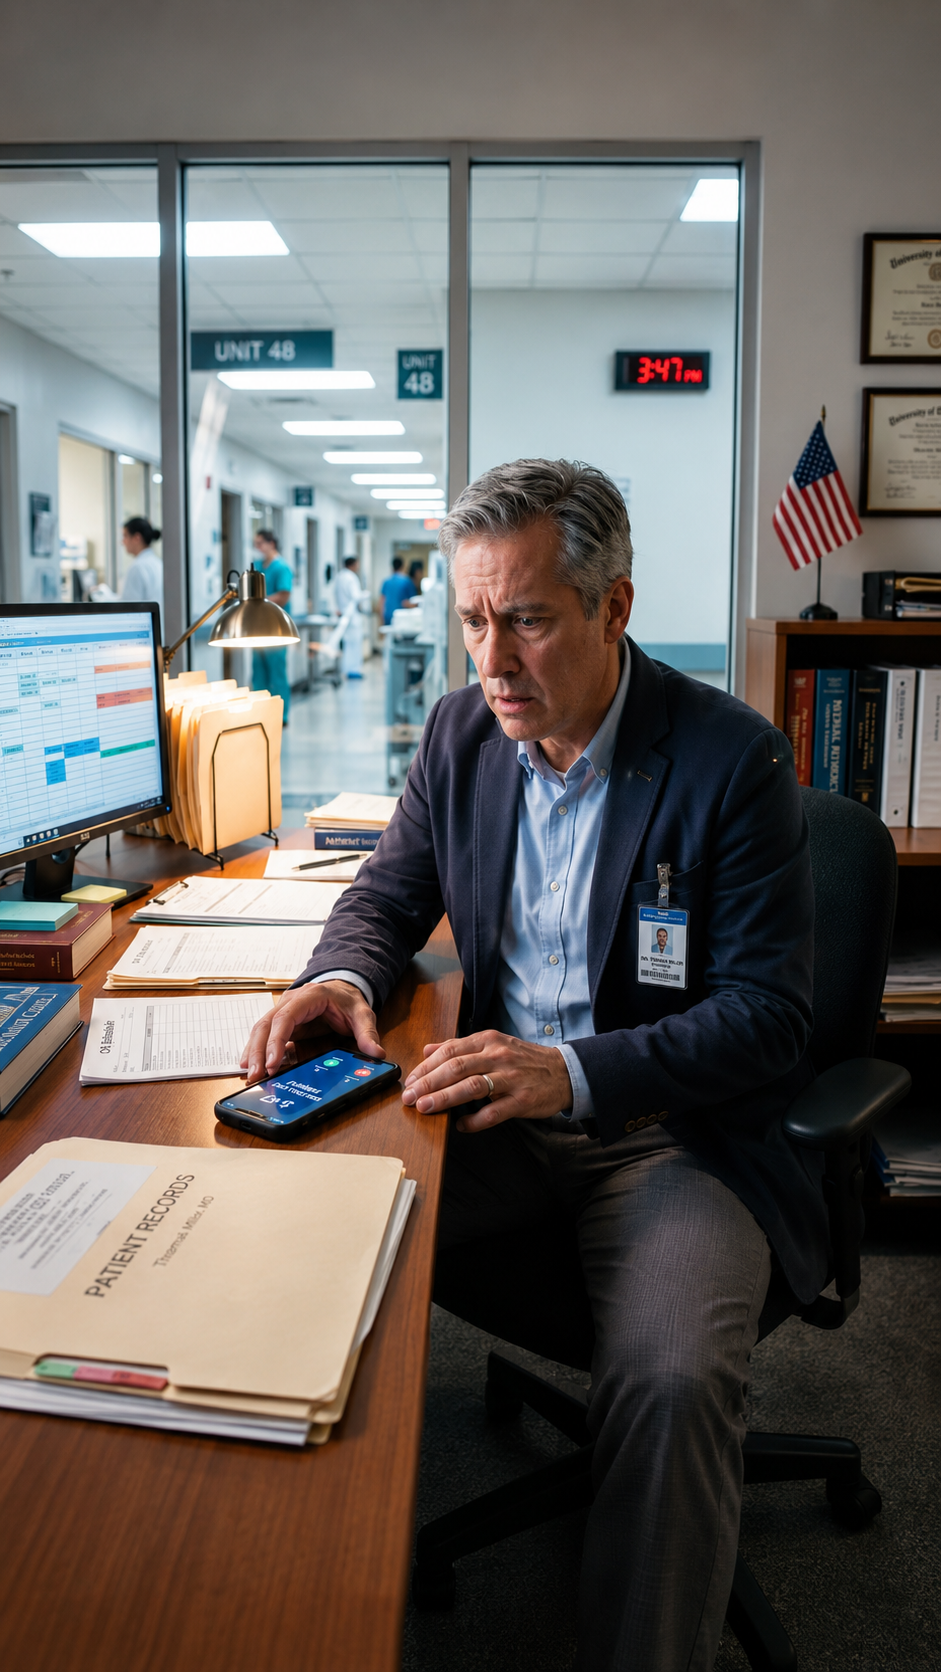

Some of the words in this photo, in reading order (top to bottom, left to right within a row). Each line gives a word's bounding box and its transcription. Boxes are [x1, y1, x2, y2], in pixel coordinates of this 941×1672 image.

[214, 340, 264, 362] UNIT
[267, 340, 296, 362] 48
[402, 354, 436, 370] UNIT
[637, 356, 683, 384] 3:47
[403, 371, 435, 394] 48
[84, 1233, 148, 1298] PATIENT
[135, 1174, 195, 1232] RECORDS
